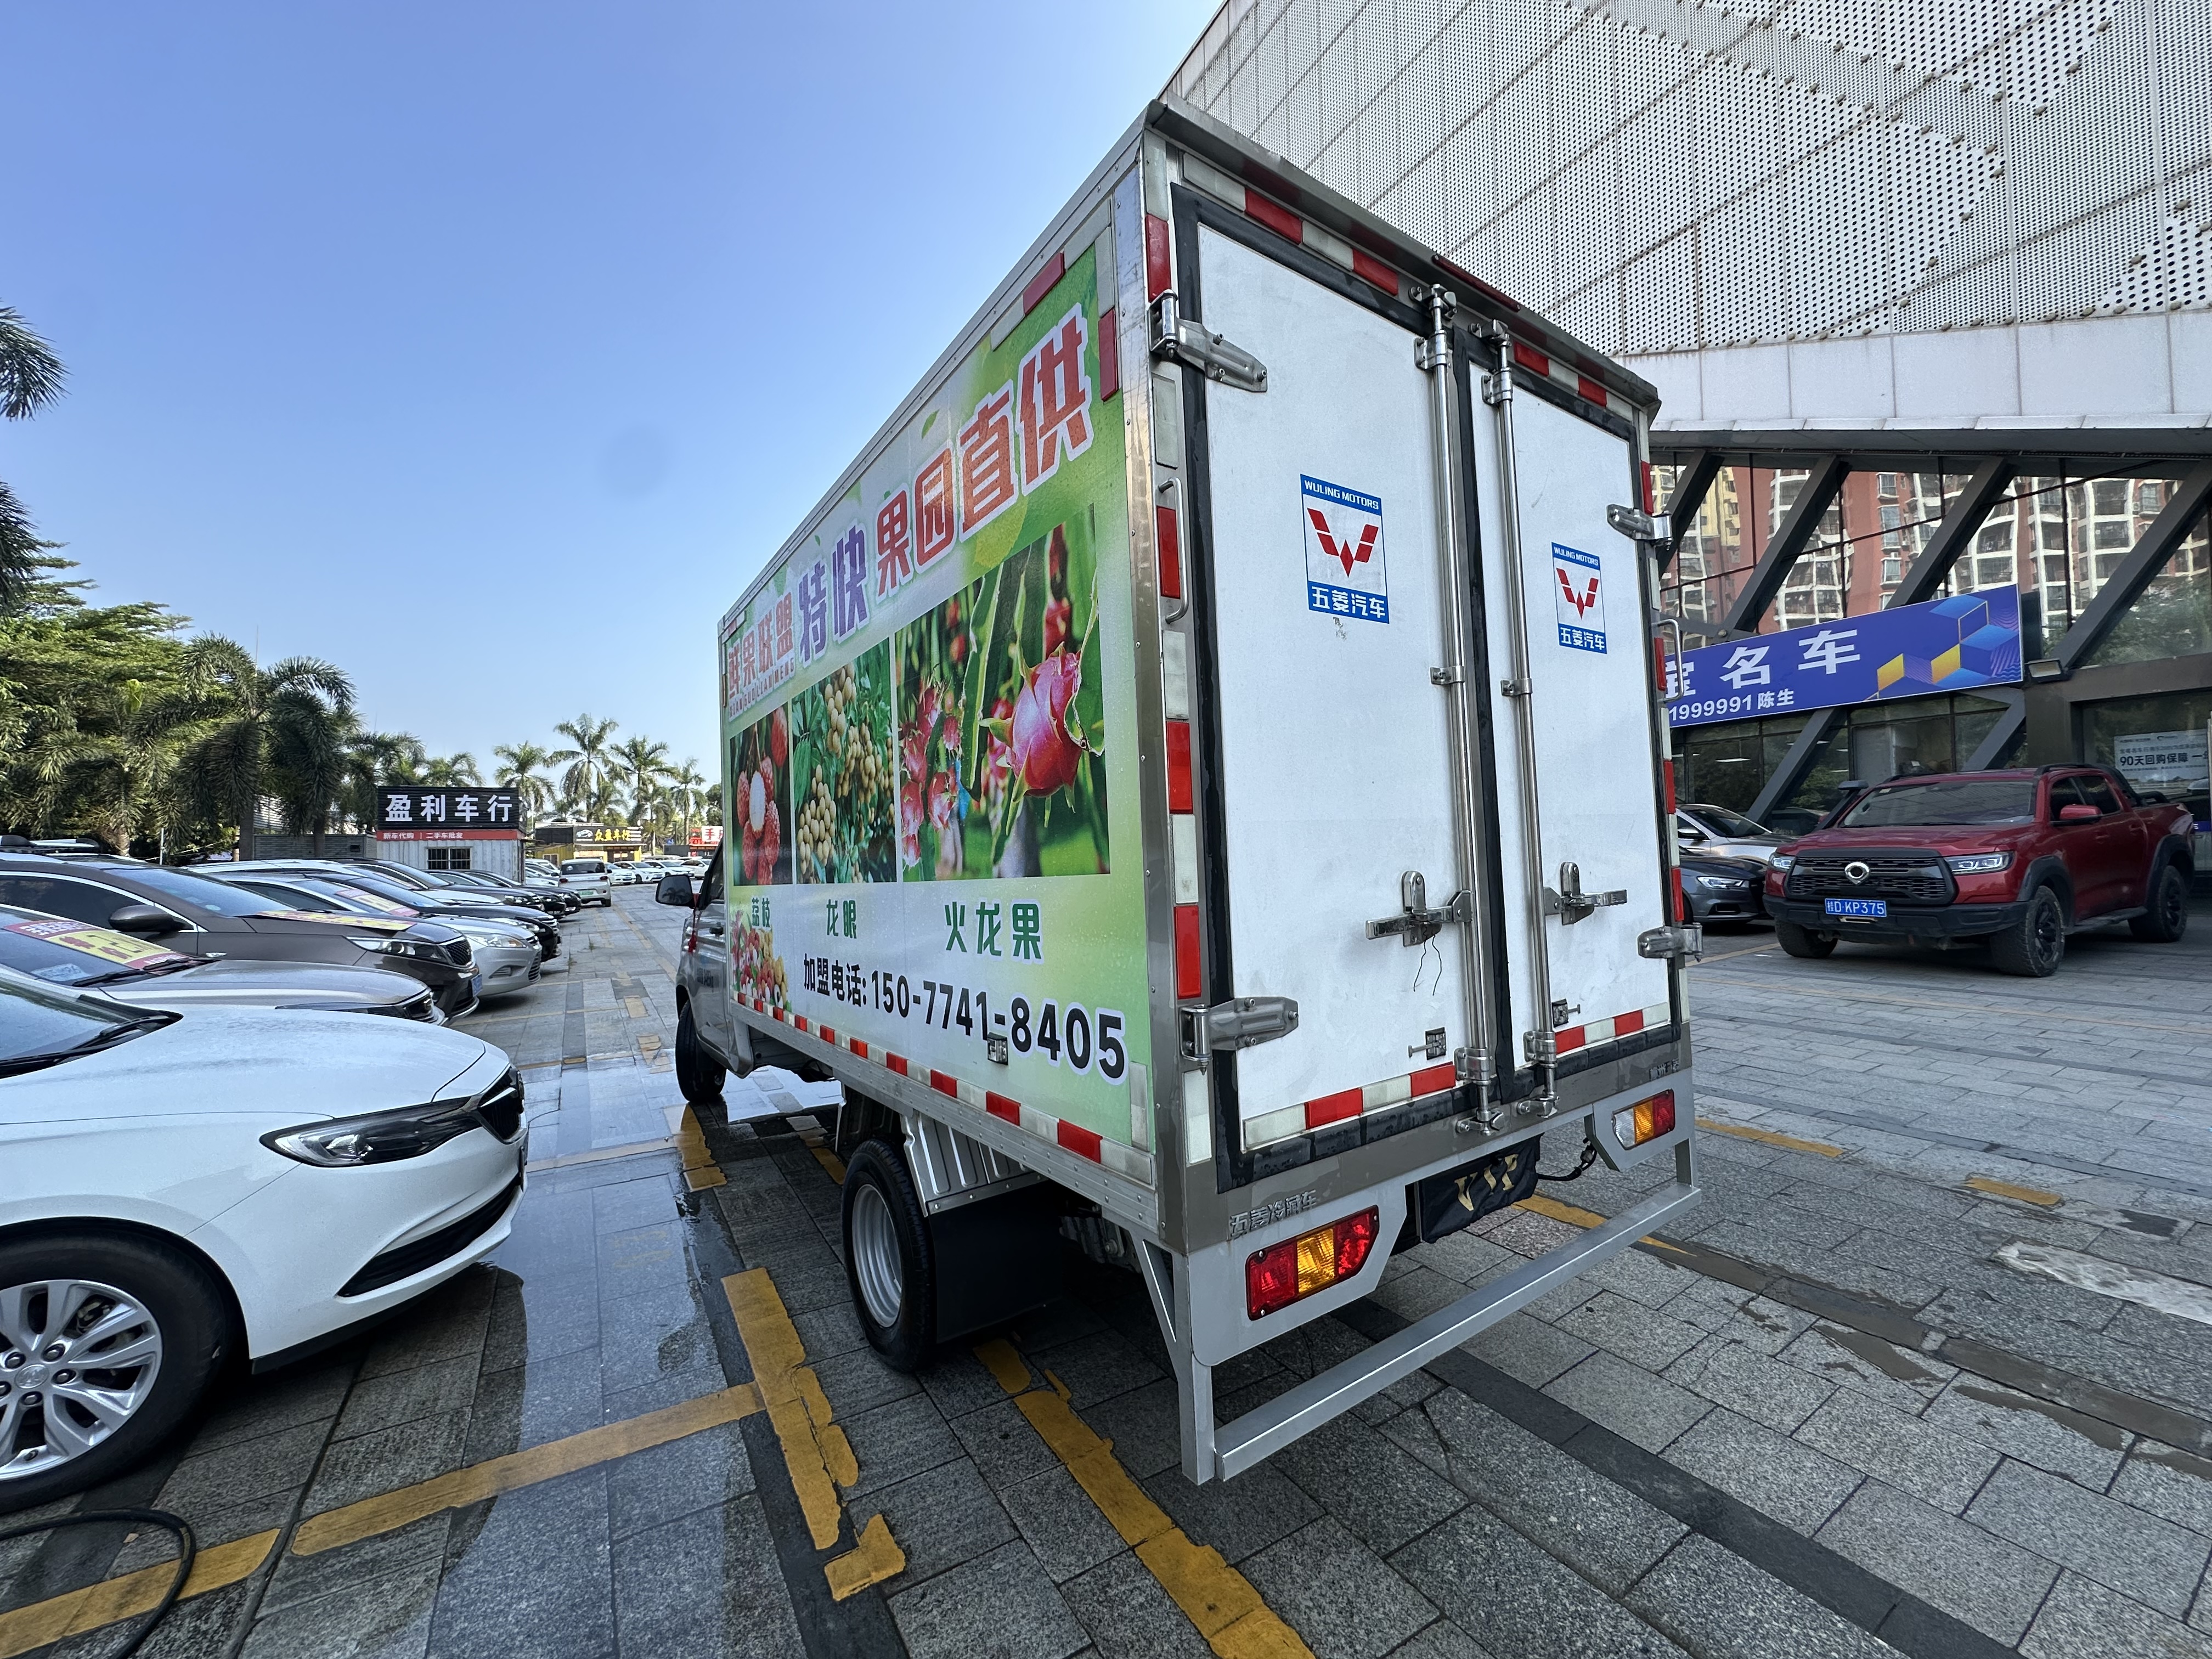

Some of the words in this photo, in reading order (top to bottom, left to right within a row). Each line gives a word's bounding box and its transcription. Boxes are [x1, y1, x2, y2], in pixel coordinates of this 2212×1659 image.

[729, 591, 793, 699] 鲜果联盟
[798, 524, 868, 663] 特快
[877, 315, 1089, 599] 果园直供
[1304, 480, 1340, 499] WULING
[1342, 491, 1379, 510] MOTORS
[1554, 546, 1576, 559] WULING
[1576, 553, 1599, 566] MOTORS
[1311, 586, 1386, 618] 五菱汽车
[1560, 627, 1605, 650] 五菱汽车
[1669, 695, 1752, 721] 1999991
[1758, 689, 1795, 709] 陈生
[2120, 752, 2188, 766] 90天回购保障
[385, 794, 513, 822] 盈利车行
[752, 898, 770, 928] 荔枝
[826, 899, 857, 939] 龙眼
[945, 901, 1042, 960] 火龙果
